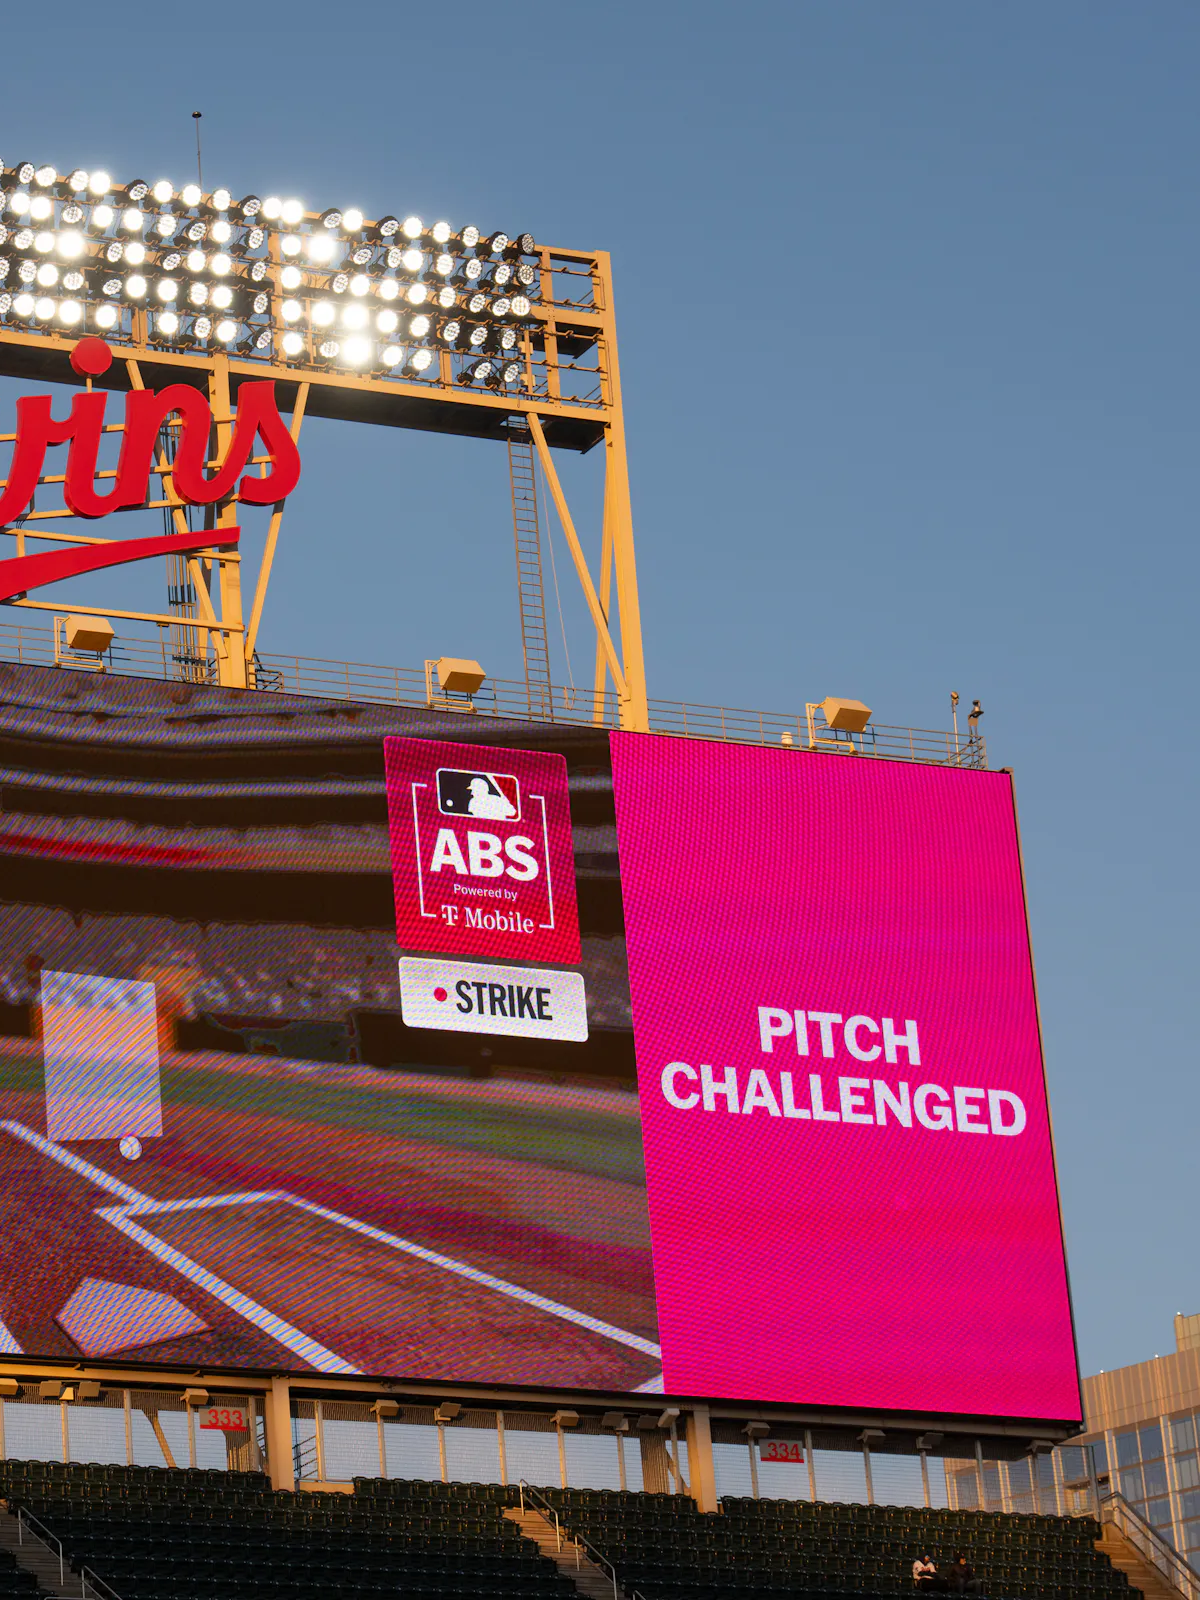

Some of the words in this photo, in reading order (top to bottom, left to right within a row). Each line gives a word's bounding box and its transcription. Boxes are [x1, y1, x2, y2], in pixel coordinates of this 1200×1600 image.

[430, 828, 539, 881] ABS
[453, 884, 502, 899] Powered
[503, 888, 518, 901] by
[465, 907, 535, 934] Mobile
[455, 980, 553, 1021] STRIKE
[757, 1006, 921, 1066] PITCH
[660, 1062, 1027, 1136] CHALLENGED
[208, 1409, 243, 1427] 333
[767, 1442, 800, 1460] 334
